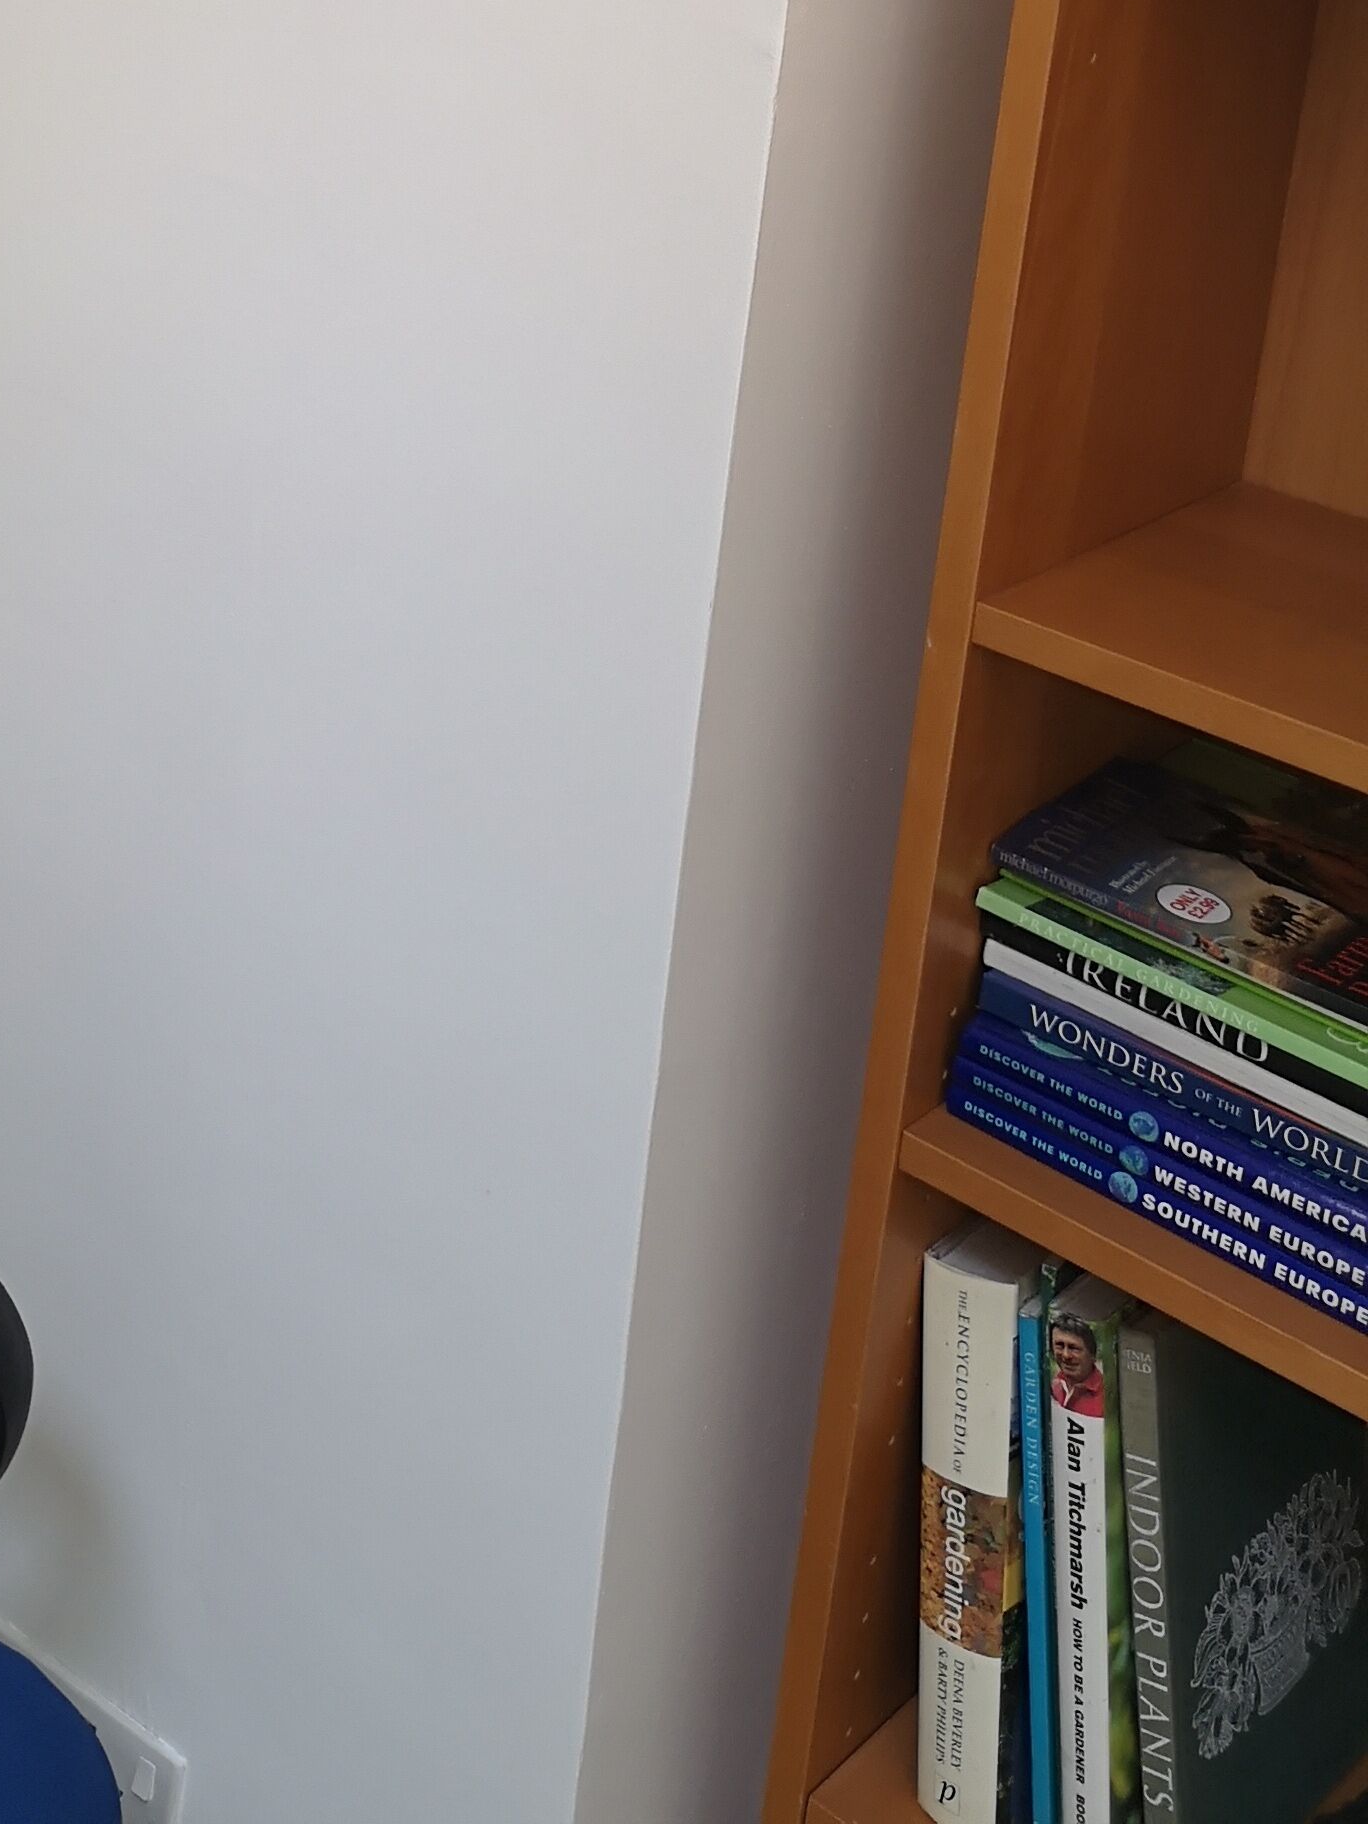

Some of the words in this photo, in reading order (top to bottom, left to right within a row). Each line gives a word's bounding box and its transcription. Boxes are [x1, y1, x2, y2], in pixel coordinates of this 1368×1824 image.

[1170, 888, 1203, 912] ONLY
[1188, 897, 1220, 920] £2.99
[1018, 911, 1124, 974] PRACTICAL
[1136, 964, 1258, 1035] GARDENING
[1064, 949, 1268, 1066] IRELAND
[1029, 1003, 1183, 1097] WONDERS
[1194, 1086, 1213, 1105] OF
[1216, 1096, 1241, 1119] THE
[979, 1043, 1044, 1084] DISCOVER
[1049, 1077, 1074, 1098] THE
[1077, 1091, 1122, 1122] WORLD
[1163, 1129, 1243, 1183] NORTH
[1252, 1171, 1366, 1243] AMERICA
[964, 1100, 1028, 1141] DISCOVER
[1032, 1135, 1054, 1156] THE
[1058, 1149, 1102, 1181] WORLD
[1141, 1190, 1264, 1270] SOUTHERN
[1274, 1260, 1368, 1326] EUROPE
[972, 1075, 1037, 1115] DISCOVER
[1041, 1110, 1066, 1131] THE
[1069, 1124, 1113, 1155] WORLD
[1154, 1165, 1258, 1233] WESTERN
[1269, 1223, 1364, 1287] EUROPE
[957, 1288, 967, 1310] THE
[952, 1311, 970, 1457] ENCYCLOPEDIA
[1023, 1351, 1037, 1427] GARDEN
[952, 1458, 961, 1474] OF
[1025, 1437, 1039, 1505] DESIGN
[1066, 1417, 1084, 1470] Alan
[936, 1484, 971, 1641] gardening
[1068, 1480, 1086, 1609] Titchmarsh
[1126, 1452, 1163, 1637] INDOOR
[938, 1647, 948, 1658] &
[1072, 1618, 1082, 1648] HOW
[1073, 1654, 1082, 1671] TO
[936, 1661, 947, 1702] BARTY
[951, 1658, 964, 1706] DEENA
[1073, 1675, 1083, 1692] BE
[1073, 1695, 1083, 1704] A
[934, 1705, 946, 1764] PHILLIPS
[949, 1707, 962, 1771] BEVERLEY
[1074, 1709, 1084, 1783] GARDENER
[1135, 1651, 1173, 1811] PLANTS
